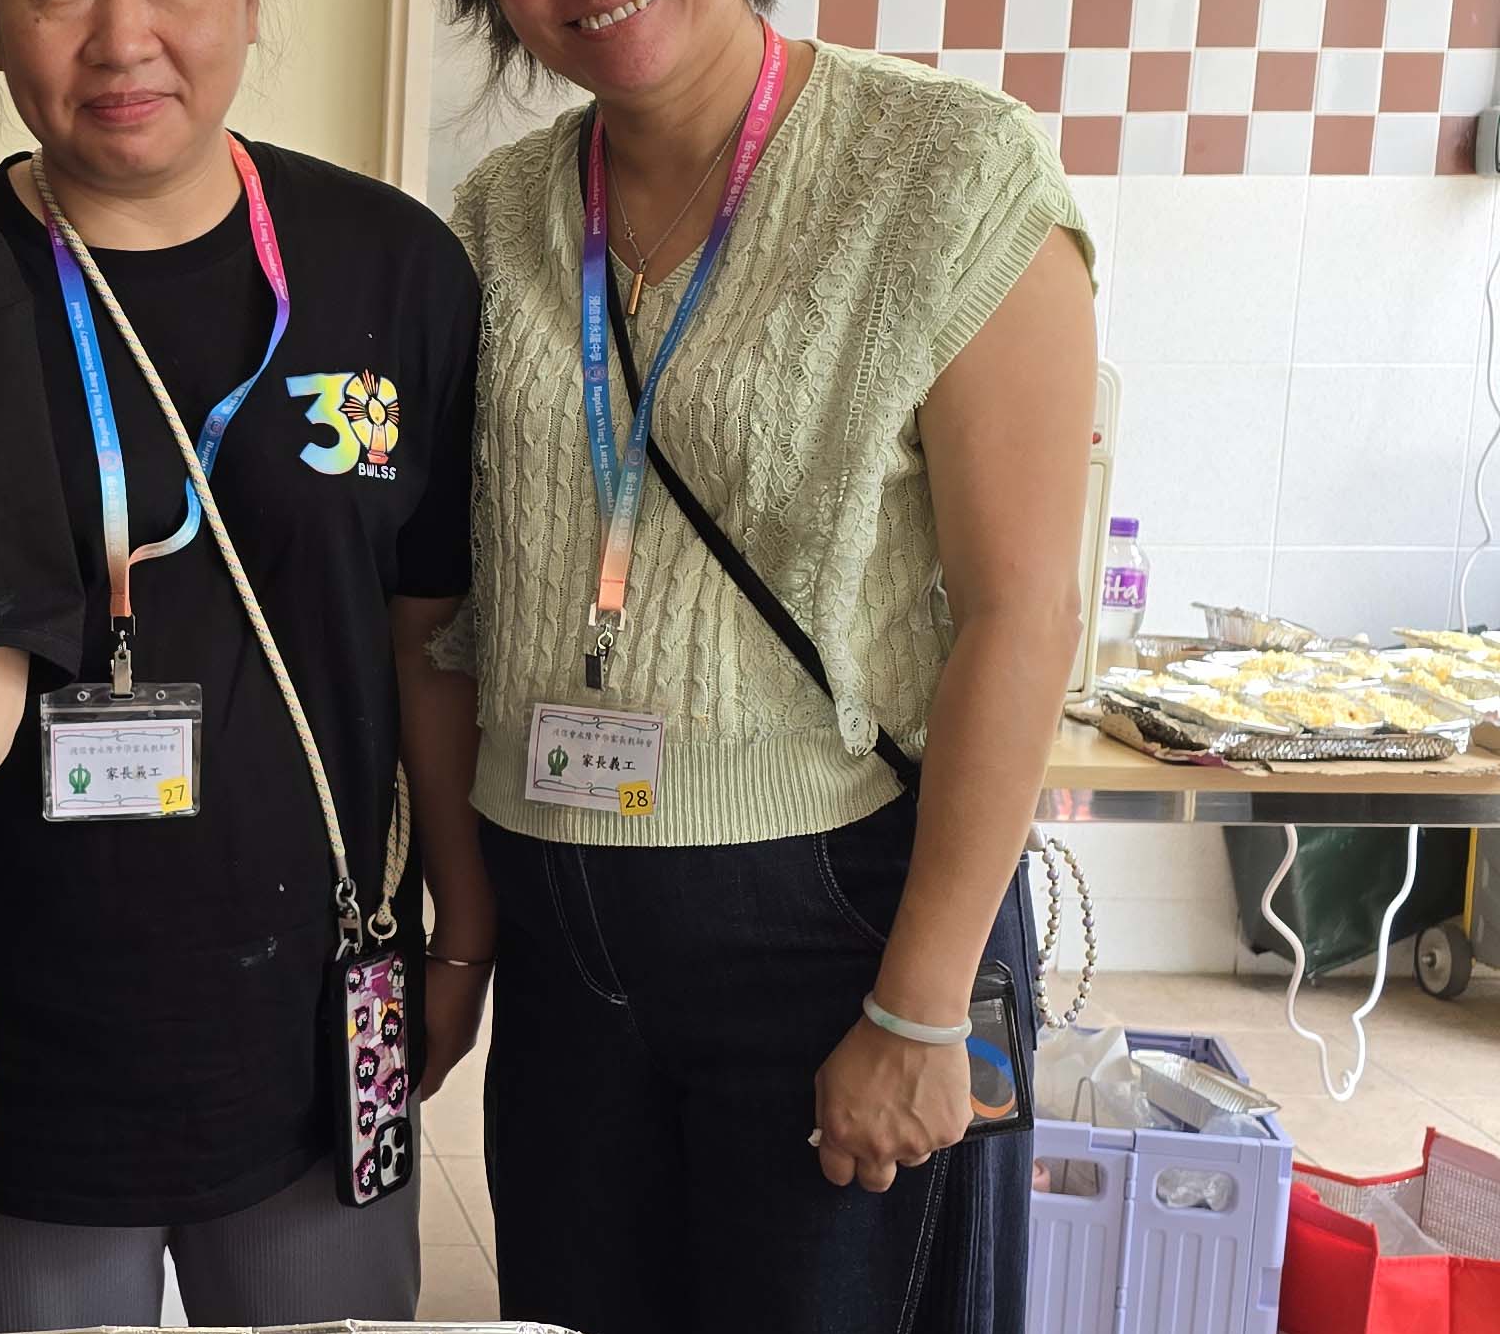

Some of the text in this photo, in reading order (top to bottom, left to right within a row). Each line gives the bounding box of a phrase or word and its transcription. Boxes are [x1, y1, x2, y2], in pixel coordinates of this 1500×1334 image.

[758, 82, 775, 112] Baptist
[767, 59, 781, 84] Wing
[70, 301, 85, 329] School
[588, 295, 602, 361] 浸信會永隆中學
[93, 394, 104, 417] Wing
[593, 385, 603, 416] Baptist
[596, 416, 607, 443] Wing
[600, 444, 610, 470] Lung
[358, 462, 397, 481] BWLSS
[1104, 569, 1139, 604] ita
[106, 765, 163, 780] 家長義工
[582, 754, 636, 771] 家長義工
[163, 784, 185, 805] 27
[623, 790, 649, 808] 28
